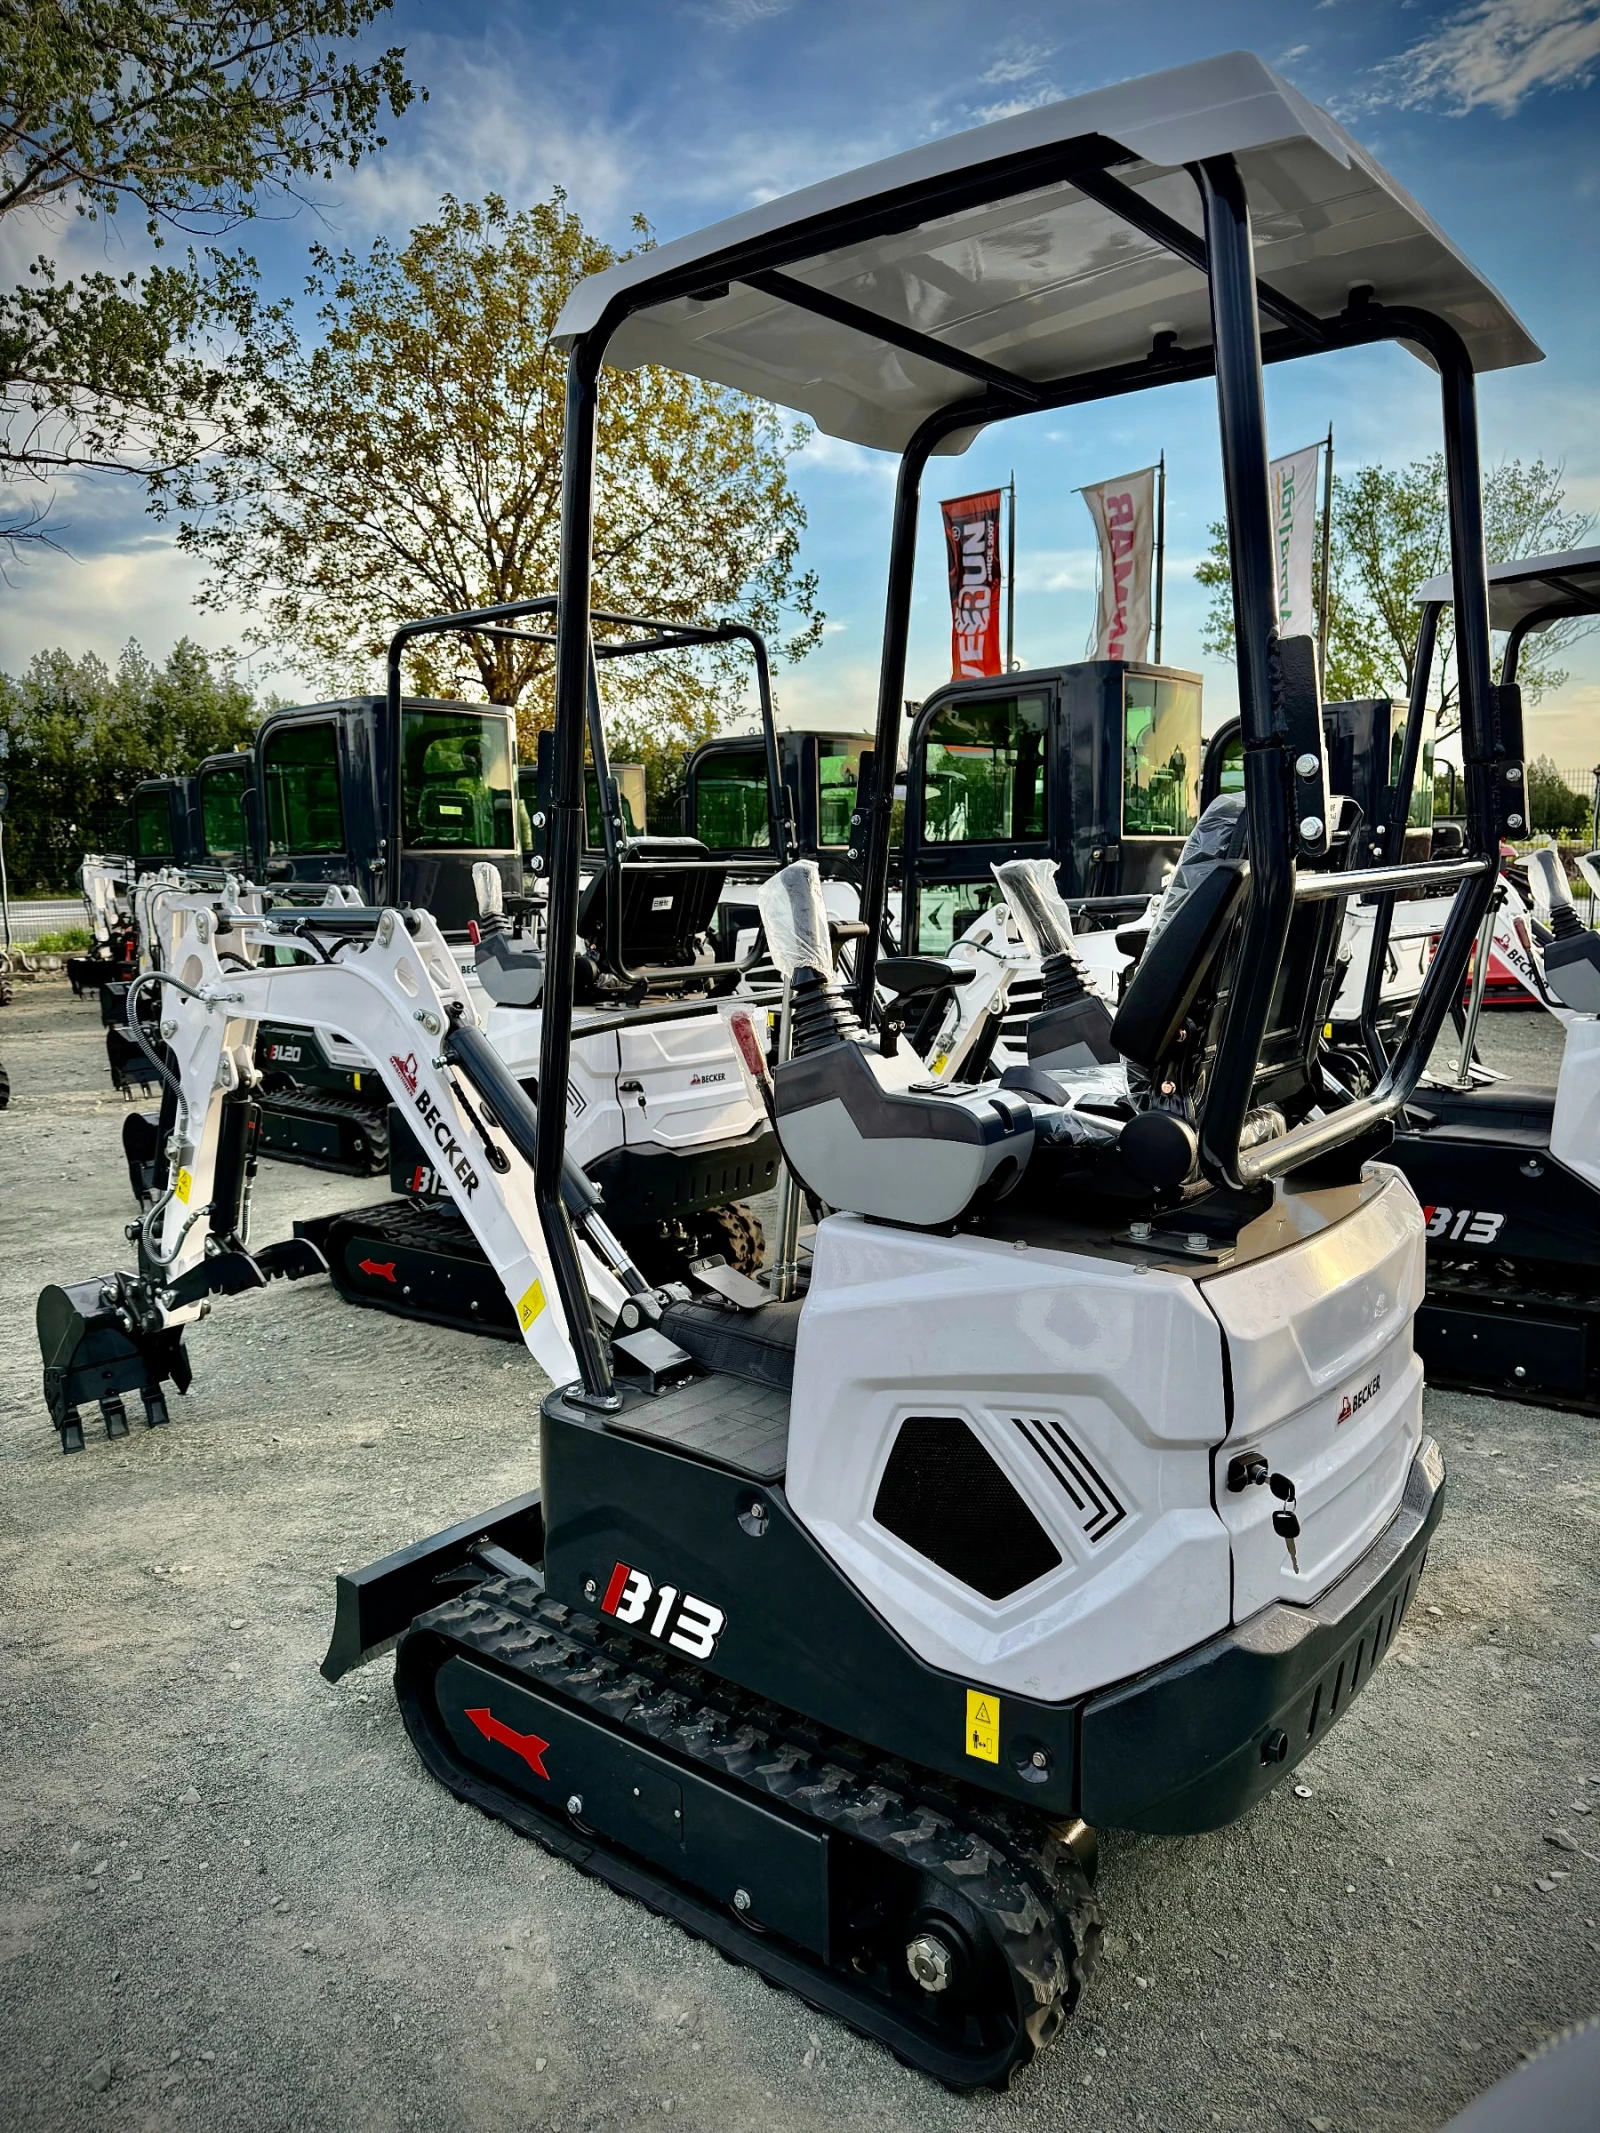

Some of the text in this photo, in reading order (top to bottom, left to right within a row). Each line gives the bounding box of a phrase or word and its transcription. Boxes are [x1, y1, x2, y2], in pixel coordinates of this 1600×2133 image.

[987, 520, 995, 546] 2007
[270, 1045, 301, 1062] BL20
[701, 1073, 726, 1084] BECKER
[415, 1089, 479, 1200] BECKER
[1424, 1206, 1504, 1244] B13
[1353, 1374, 1381, 1414] BECKER
[601, 1562, 725, 1660] B13
